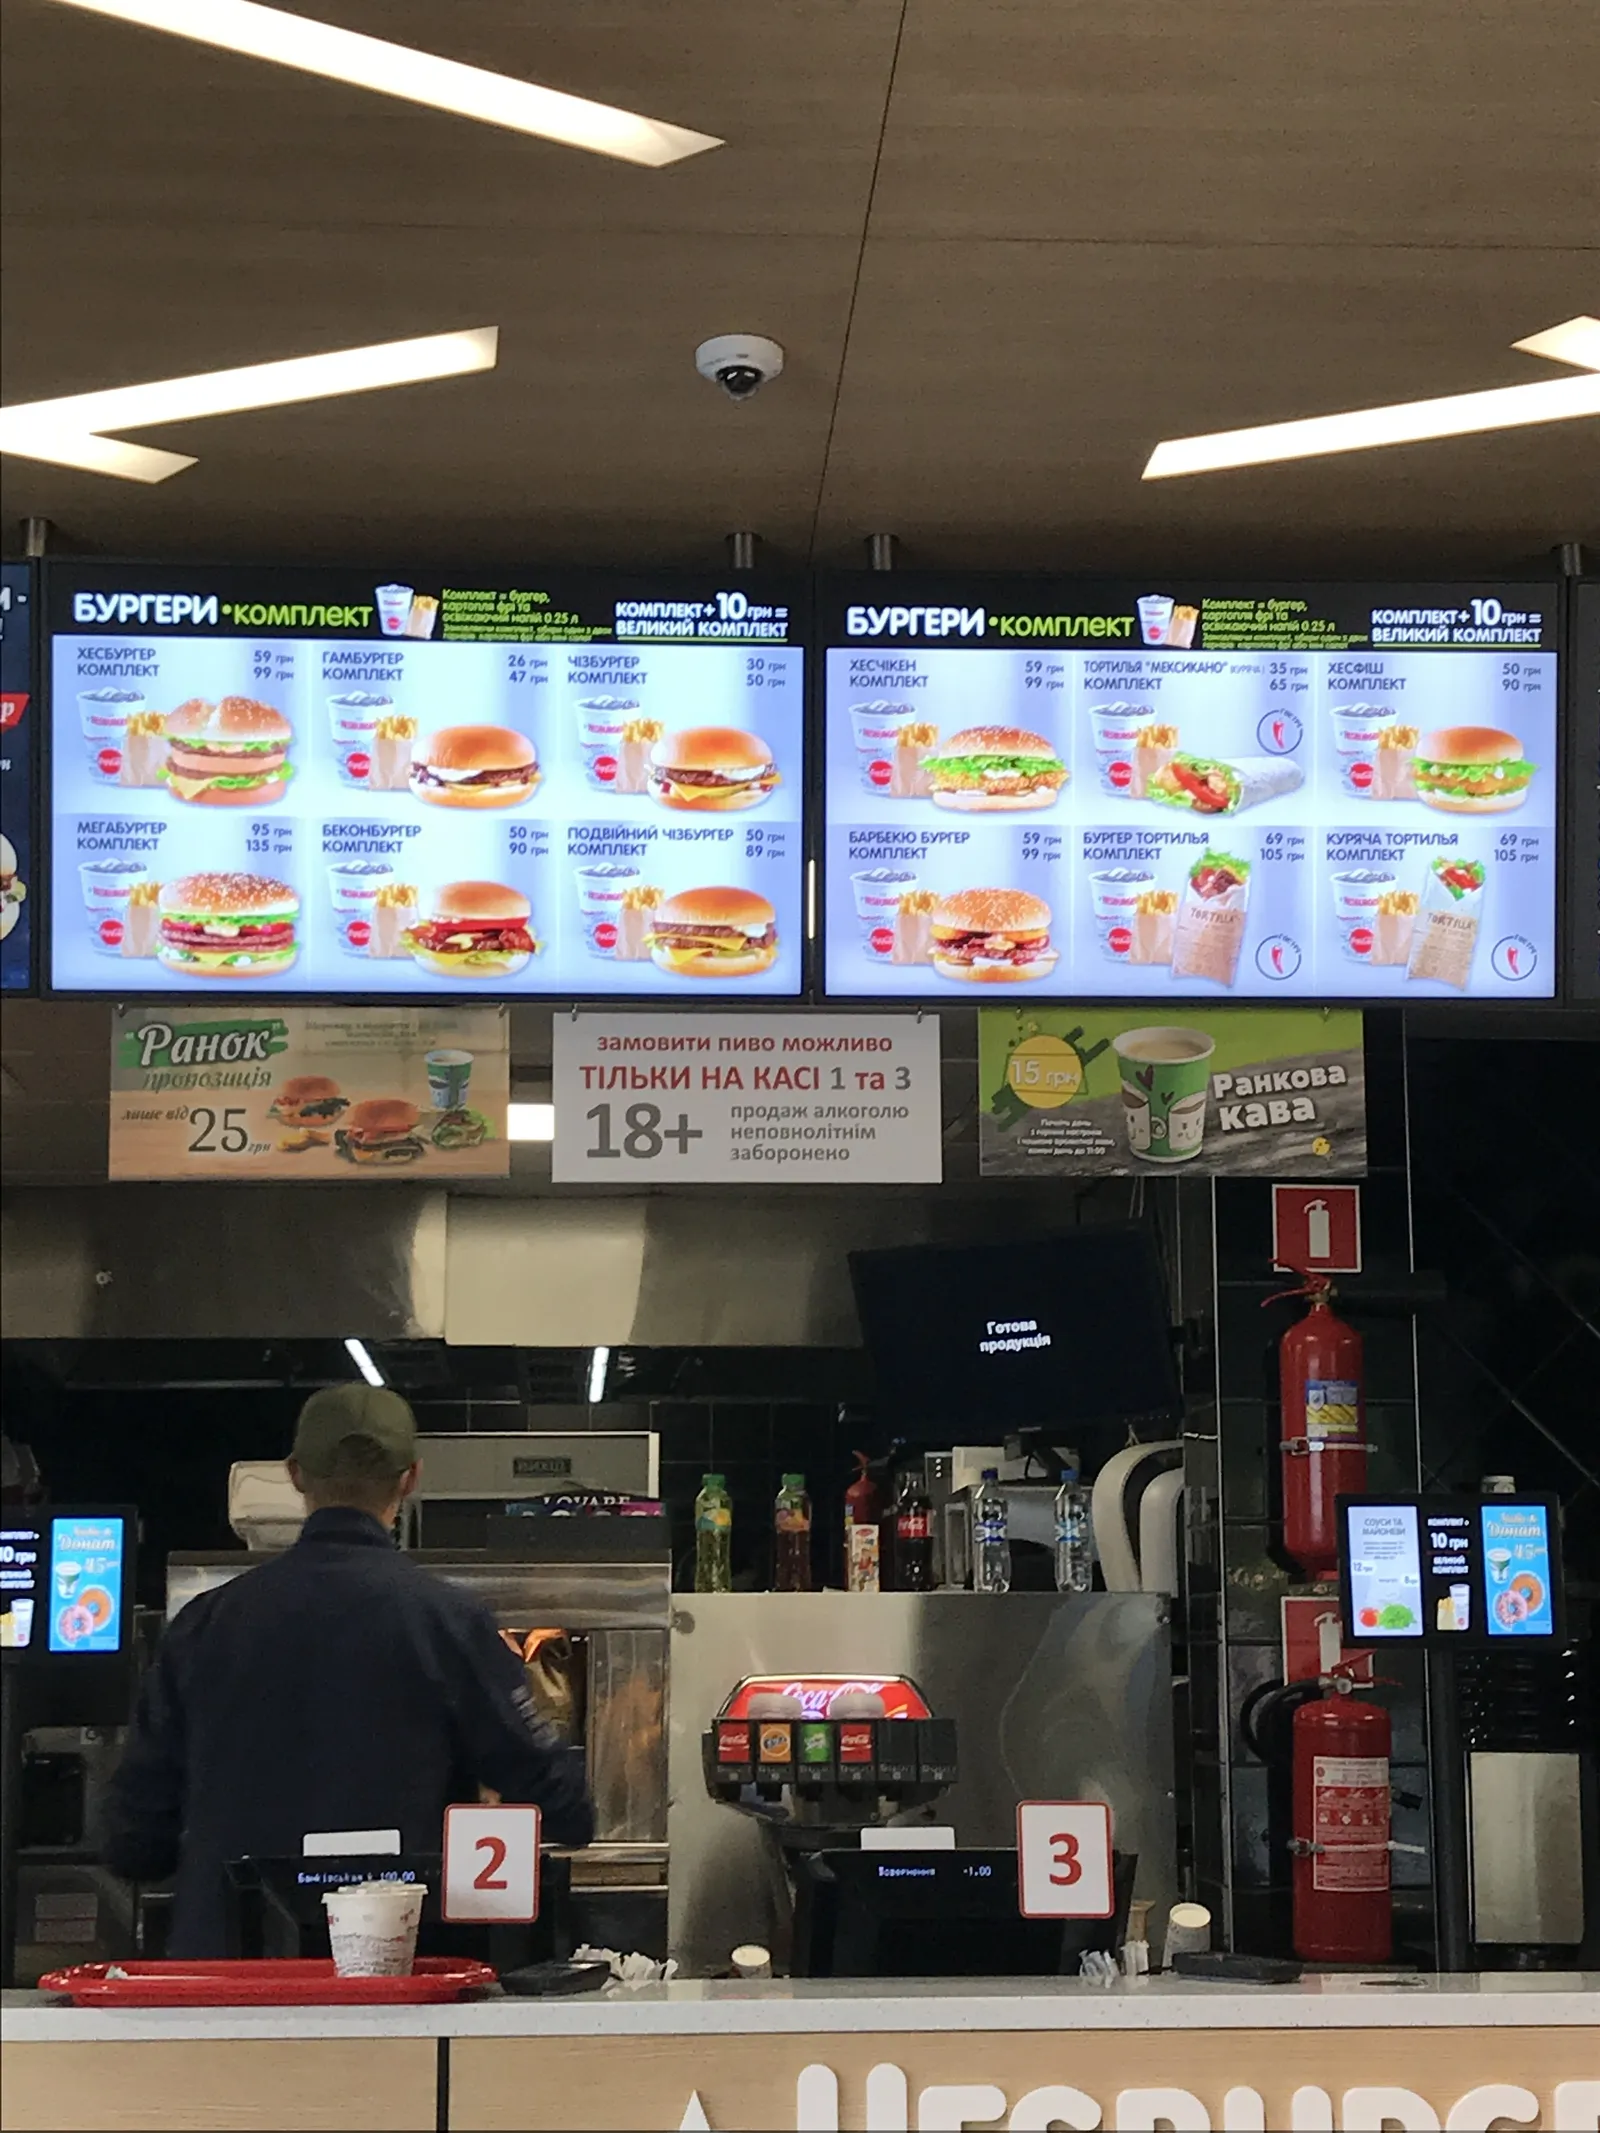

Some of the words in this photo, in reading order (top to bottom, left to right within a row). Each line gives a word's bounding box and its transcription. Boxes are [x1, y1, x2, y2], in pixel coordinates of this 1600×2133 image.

[74, 593, 218, 624] БУРГЕРИ
[233, 603, 373, 628] комплект
[715, 592, 747, 619] 10
[1471, 599, 1501, 626] 10
[847, 606, 985, 636] БУРГЕРИ
[1000, 616, 1135, 637] комплект
[616, 619, 694, 636] ВЕЛИКИЙ
[699, 622, 788, 638] КОМПЛЕКТ
[1372, 626, 1448, 642] ВЕЛИКИЙ
[1453, 628, 1542, 643] КОМПЛЕКТ
[77, 647, 155, 660] ХЕСБУРГЕР
[254, 651, 271, 662] 59
[322, 652, 403, 664] ГАМБУРГЕР
[508, 656, 526, 667] 26
[568, 656, 640, 668] ЧІЗБУРГЕР
[747, 659, 764, 670] 30
[850, 659, 916, 672] ХЕСЧІКЕН
[1025, 661, 1042, 673] 59
[1084, 661, 1142, 673] ТОРТИЛЬЯ
[77, 664, 159, 677] КОМПЛЕКТ
[254, 667, 271, 679] 99
[322, 668, 403, 680] КОМПЛЕКТ
[1270, 663, 1287, 674] 35
[1327, 663, 1383, 674] ХЕСФІШ
[1502, 663, 1520, 675] 50
[509, 672, 526, 683] 47
[568, 672, 647, 684] КОМПЛЕКТ
[747, 675, 764, 687] 50
[850, 675, 928, 688] КОМПЛЕКТ
[1025, 677, 1042, 688] 99
[1084, 678, 1163, 690] КОМПЛЕКТ
[1270, 679, 1287, 690] 65
[1327, 678, 1406, 690] КОМПЛЕКТ
[1502, 679, 1520, 690] 90
[77, 822, 167, 834] МЕГАБУРГЕР
[252, 824, 269, 836] 95
[322, 824, 421, 837] БЕКОНБУРГЕР
[509, 826, 527, 838] 50
[568, 827, 658, 840] ПОДВІЙНИЙ
[663, 829, 733, 841] ЧІЗБУРГЕР
[746, 829, 763, 841] 50
[849, 832, 917, 844] БАРБЕКЮ
[921, 832, 970, 844] БУРГЕР
[1023, 833, 1040, 845] 59
[1083, 832, 1133, 845] БУРГЕР
[1137, 832, 1209, 845] ТОРТИЛЬЯ
[1266, 833, 1283, 844] 69
[1327, 833, 1381, 845] КУРЯЧА
[1386, 833, 1458, 845] ТОРТИЛЬЯ
[1500, 833, 1517, 845] 69
[77, 838, 158, 850] КОМПЛЕКТ
[246, 839, 269, 852] 135
[322, 841, 403, 853] КОМПЛЕКТ
[509, 843, 527, 855] 90
[568, 843, 647, 856] КОМПЛЕКТ
[746, 845, 763, 857] 89
[849, 847, 927, 860] КОМПЛЕКТ
[1022, 848, 1039, 860] 99
[1083, 848, 1162, 860] КОМПЛЕКТ
[1260, 849, 1282, 861] 105
[1327, 848, 1405, 861] КОМПЛЕКТ
[1495, 849, 1516, 861] 105
[597, 1036, 711, 1052] замовити
[718, 1036, 774, 1052] пиво
[783, 1036, 892, 1053] можливо
[579, 1065, 690, 1090] ТІЛЬКИ
[702, 1065, 744, 1090] НА
[754, 1065, 819, 1090] КАСІ
[831, 1066, 845, 1090] 1
[855, 1071, 885, 1090] та
[896, 1066, 911, 1090] 3
[1011, 1059, 1039, 1085] 15
[1213, 1063, 1346, 1099] Ранкова
[731, 1105, 808, 1120] продаж
[813, 1105, 909, 1120] алкоголю
[1220, 1096, 1315, 1132] кава
[188, 1107, 250, 1153] 25
[247, 1140, 271, 1157] грн
[586, 1102, 703, 1159] 18+
[731, 1125, 876, 1142] неповнолітнім
[731, 1145, 850, 1163] заборонено
[986, 1319, 1037, 1334] Готова
[980, 1334, 1051, 1354] продукція
[1430, 1532, 1447, 1548] 10
[473, 1836, 508, 1890] 2
[1049, 1833, 1082, 1886] 3
